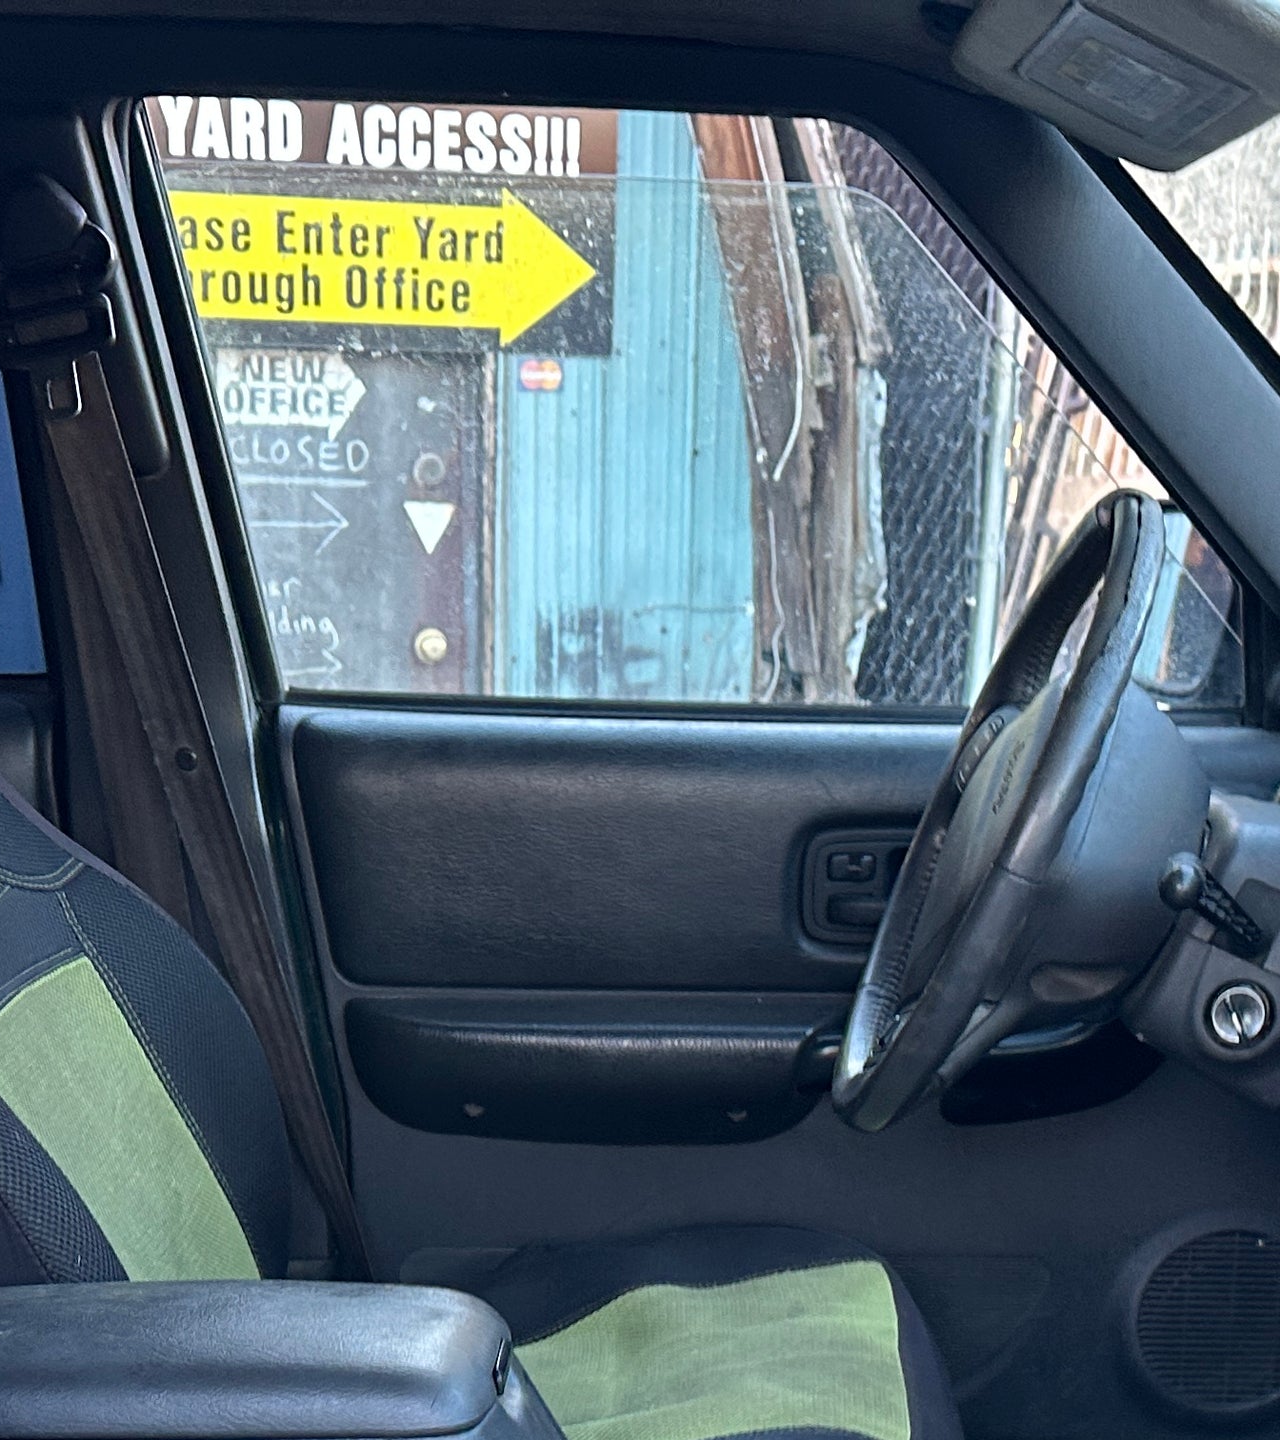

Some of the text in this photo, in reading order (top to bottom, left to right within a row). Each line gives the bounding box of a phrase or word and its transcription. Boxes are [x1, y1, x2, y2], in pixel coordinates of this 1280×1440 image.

[157, 96, 581, 178] YARD ACCESS!!!
[277, 209, 391, 258] Enter
[414, 216, 504, 264] Yard
[189, 263, 471, 314] rough Office
[240, 354, 326, 384] NEW
[223, 380, 347, 417] OFFICE
[230, 434, 370, 473] CLOSED
